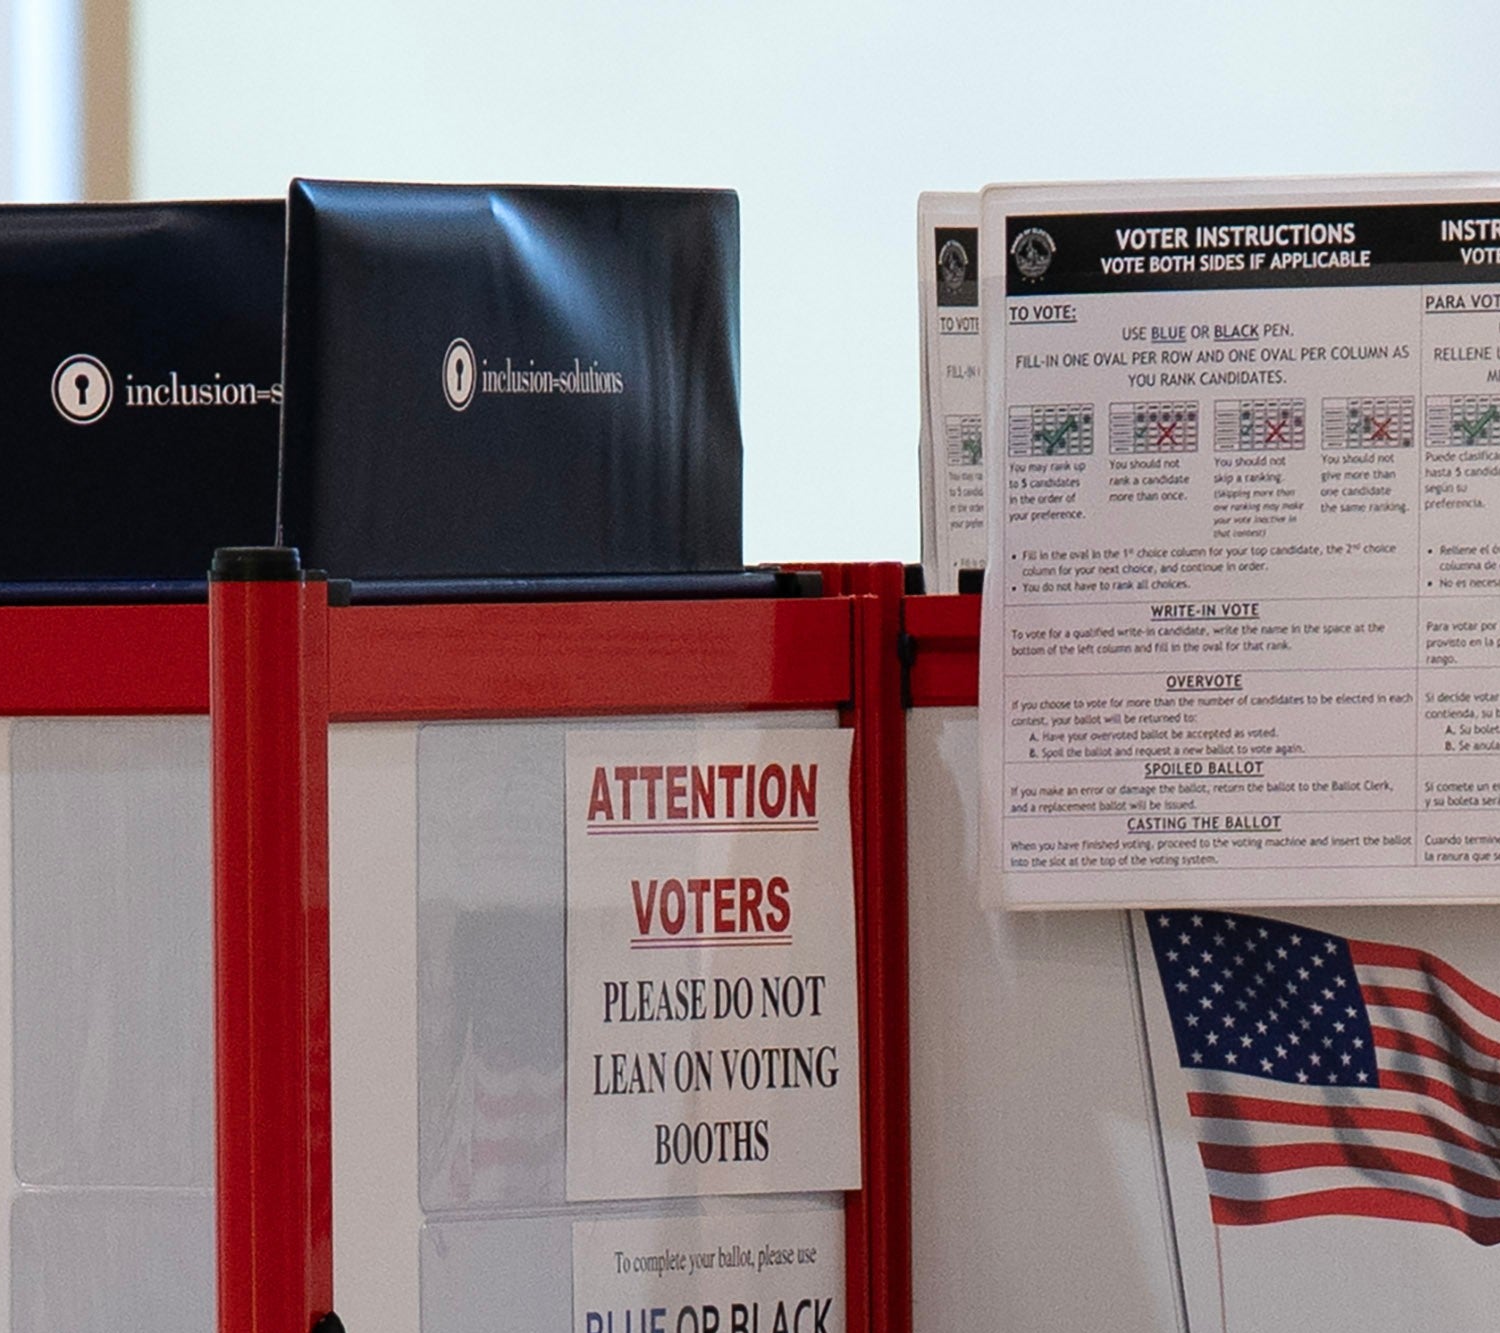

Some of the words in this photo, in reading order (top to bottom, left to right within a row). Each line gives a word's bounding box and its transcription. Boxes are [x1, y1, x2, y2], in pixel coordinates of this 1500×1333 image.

[1116, 228, 1189, 250] VOTER
[1196, 223, 1355, 248] INSTRUCTIONS
[1101, 256, 1145, 274] VOTE
[1150, 255, 1195, 273] BOTH
[1200, 254, 1245, 271] SIDES
[1250, 253, 1266, 270] IF
[1270, 250, 1371, 270] APPLICABLE
[1426, 295, 1466, 310] PARA
[1009, 306, 1029, 321] TO
[1033, 305, 1076, 320] VOTE:
[1122, 326, 1146, 341] USE
[1151, 326, 1186, 341] BLUE
[1191, 325, 1209, 339] OR
[1214, 324, 1259, 339] BLACK
[1264, 323, 1294, 337] PEN.
[1016, 354, 1059, 369] FILL-IN
[1062, 353, 1089, 367] ONE
[1093, 352, 1128, 367] OVAL
[1132, 351, 1157, 365] PER
[1161, 350, 1193, 365] ROW
[1196, 349, 1225, 363] AND
[1228, 348, 1256, 363] ONE
[1260, 348, 1297, 362] OVAL
[1301, 347, 1326, 361] PER
[1330, 346, 1388, 361] COLUMN
[1392, 345, 1410, 359] AS
[1434, 346, 1492, 362] RELLENE
[1128, 373, 1156, 388] YOU
[1160, 372, 1196, 386] RANK
[1199, 370, 1287, 386] CANDIDATES.
[1109, 460, 1127, 470] You
[1129, 459, 1161, 470] should
[1163, 459, 1180, 469] not
[1109, 476, 1130, 486] rank
[1133, 477, 1140, 485] a
[1142, 475, 1190, 485] candidate
[1151, 604, 1216, 617] WRITE-IN
[1222, 603, 1259, 618] VOTE
[1166, 674, 1242, 688] OVERVOTE
[1145, 762, 1203, 776] SPOILED
[1208, 761, 1264, 775] BALLOT
[588, 764, 817, 820] ATTENTION
[1127, 817, 1187, 831] CASTING
[1192, 816, 1219, 830] THE
[1225, 815, 1281, 830] BALLOT
[631, 877, 790, 935] VOTERS
[604, 979, 706, 1022] PLEASE
[714, 977, 753, 1019] DO
[761, 976, 825, 1018] NOT
[594, 1052, 666, 1095] LEAN
[674, 1050, 712, 1093] ON
[721, 1046, 839, 1090] VOTING
[656, 1120, 769, 1165] BOOTHS
[614, 1251, 631, 1274] To
[633, 1249, 686, 1276] complete
[688, 1253, 716, 1275] your
[718, 1245, 755, 1268] ballot,
[757, 1244, 794, 1272] please
[797, 1247, 817, 1264] use
